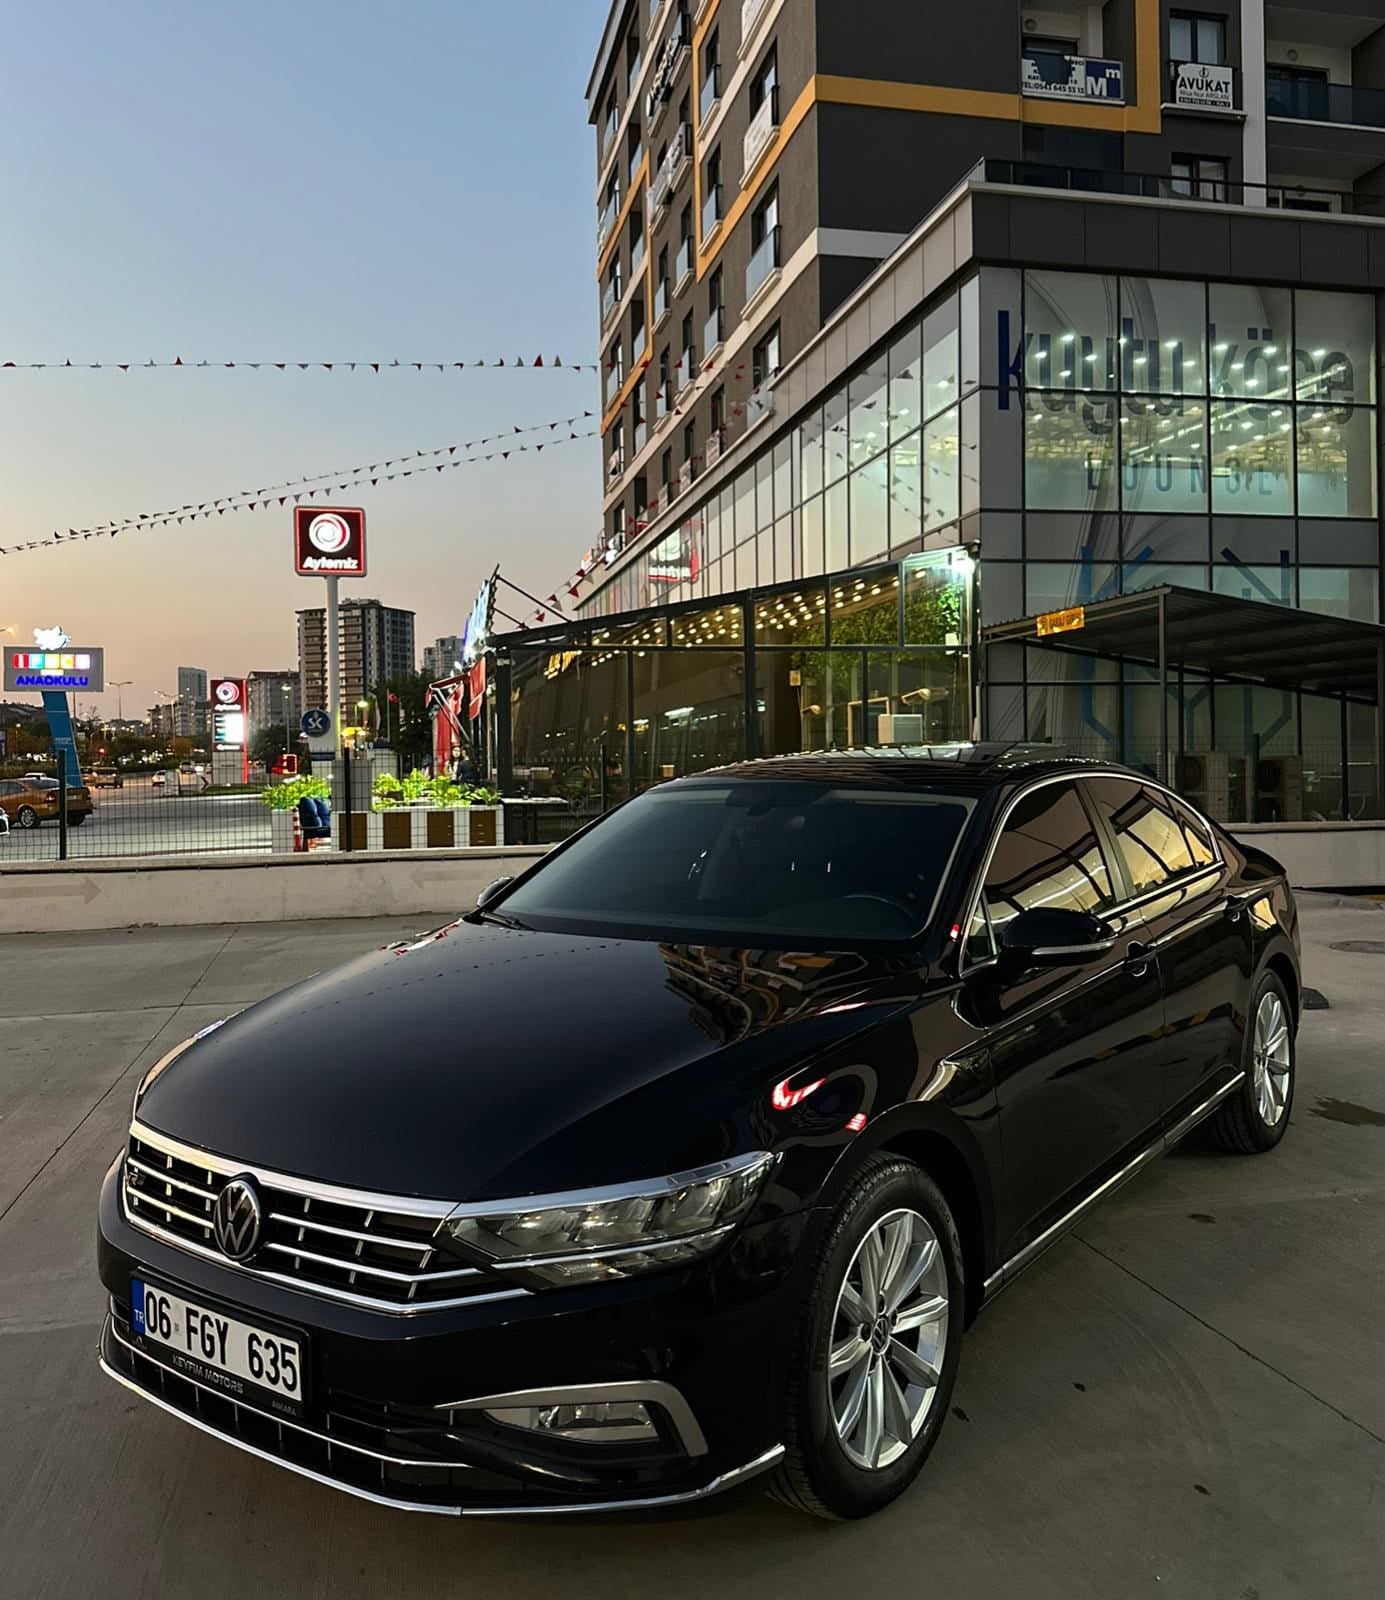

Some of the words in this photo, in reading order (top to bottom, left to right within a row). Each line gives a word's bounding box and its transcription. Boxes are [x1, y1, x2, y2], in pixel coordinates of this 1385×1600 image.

[1179, 76, 1230, 93] AVUKAT
[1086, 451, 1273, 496] LOUNGE
[303, 556, 358, 571] Aytemiz
[16, 674, 89, 686] ANAOKULU
[134, 1308, 145, 1325] TR
[145, 1290, 172, 1340] 06
[185, 1306, 229, 1366] FGY
[247, 1332, 298, 1392] 635
[205, 1369, 244, 1395] MOTORS
